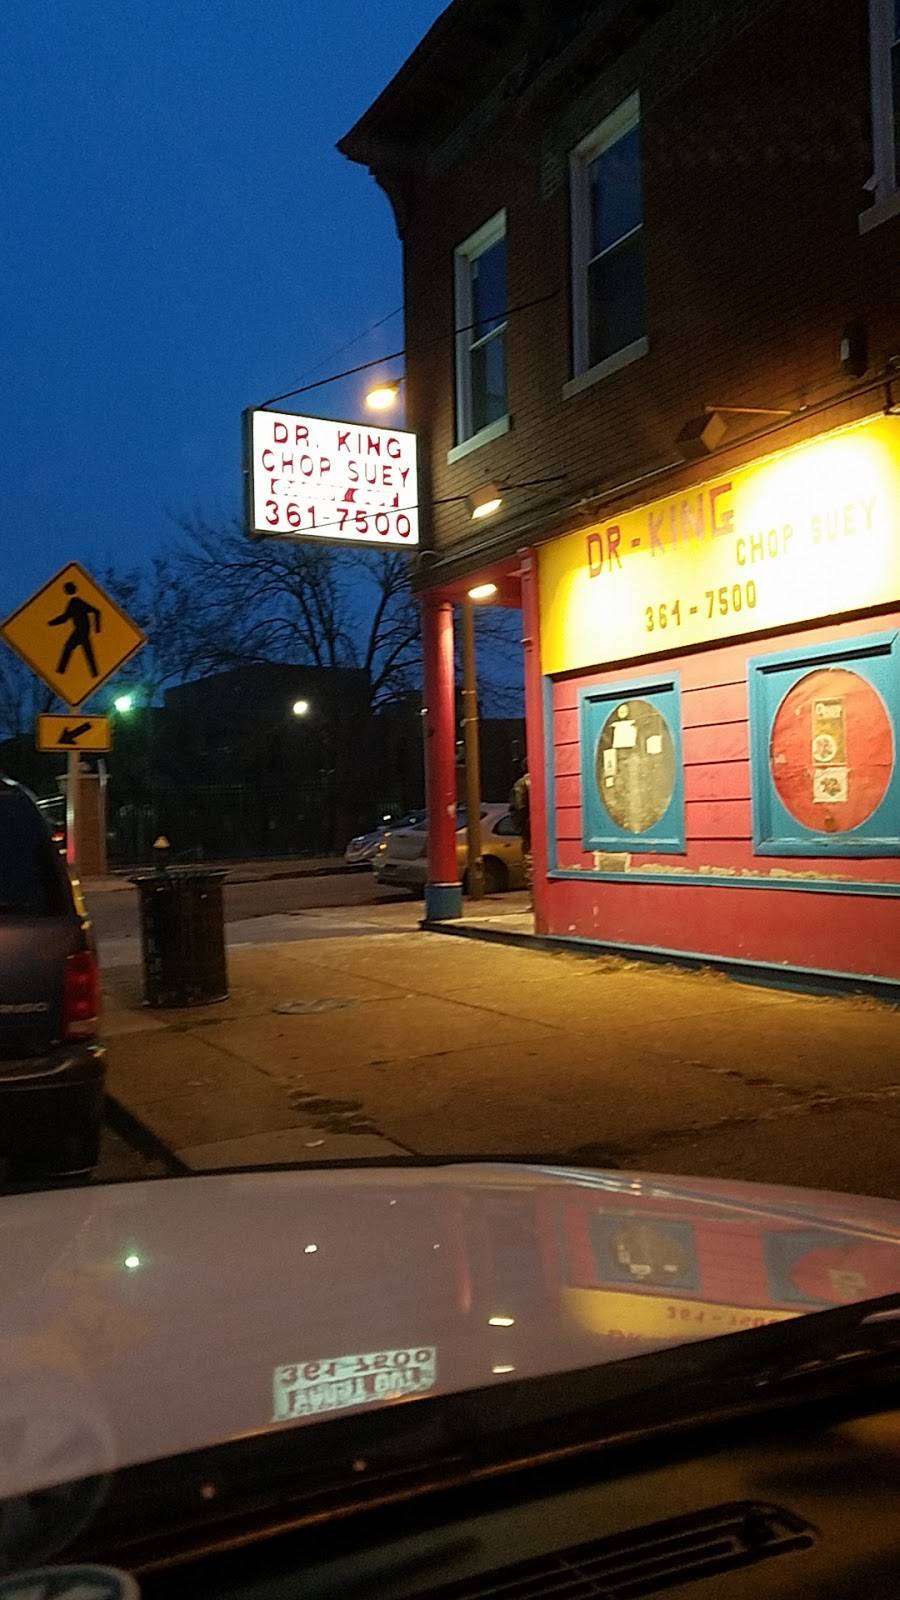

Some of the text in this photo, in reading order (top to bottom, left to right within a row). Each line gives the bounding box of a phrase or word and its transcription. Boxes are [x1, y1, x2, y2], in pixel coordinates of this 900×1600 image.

[273, 421, 402, 460] DR. KING
[261, 449, 410, 488] CHOP SUEY
[265, 499, 411, 538] 361-7500
[736, 495, 877, 567] CHOP SUEY
